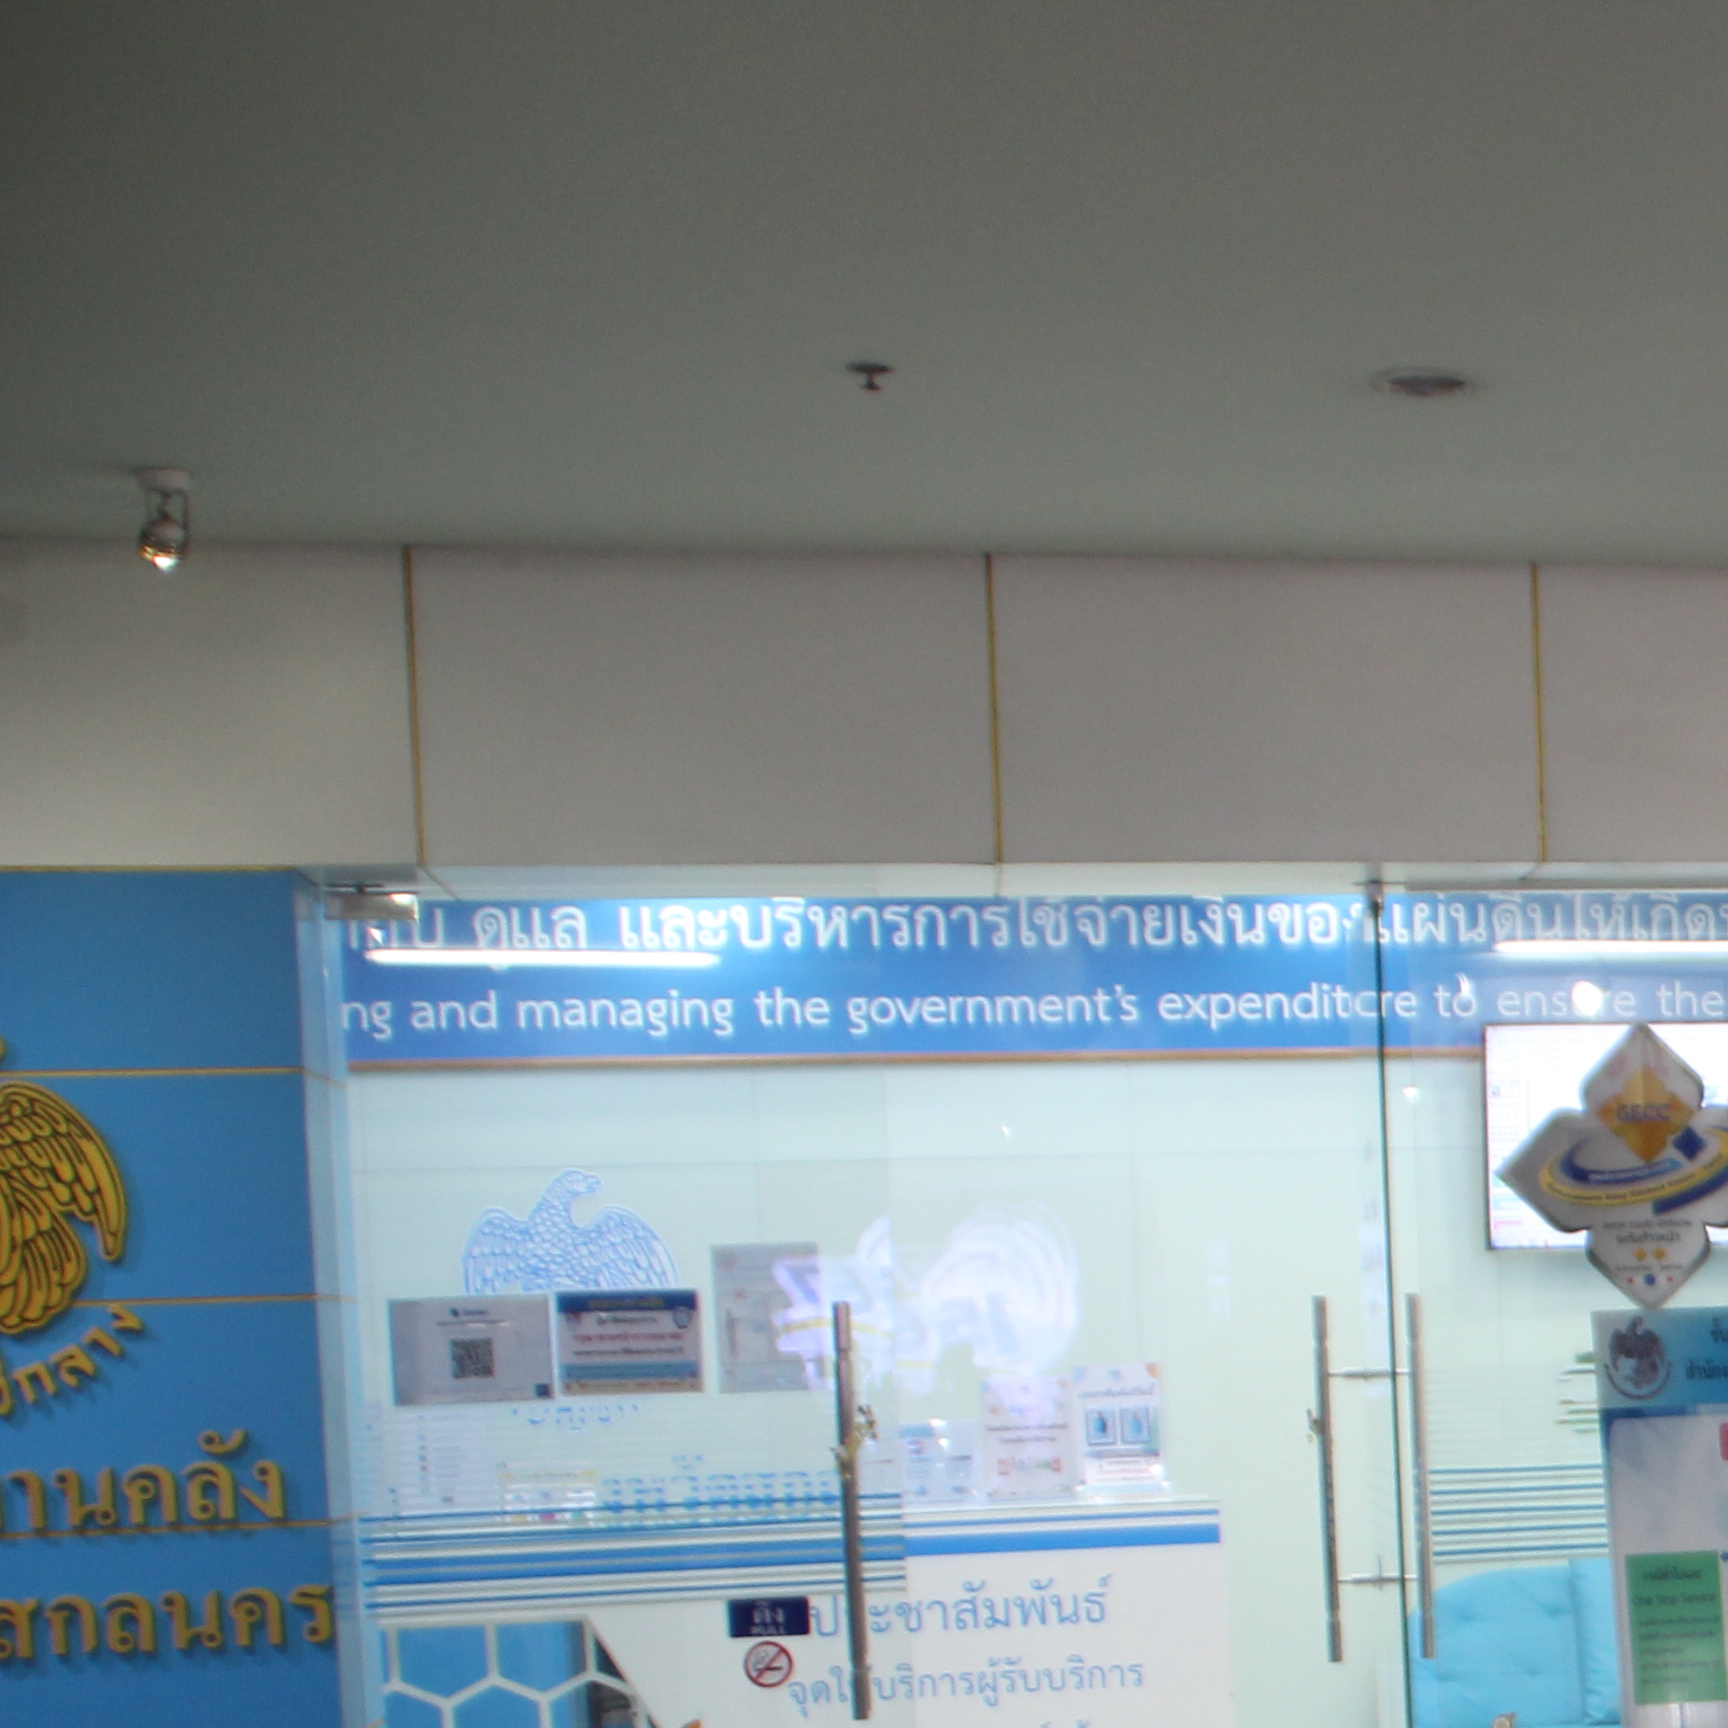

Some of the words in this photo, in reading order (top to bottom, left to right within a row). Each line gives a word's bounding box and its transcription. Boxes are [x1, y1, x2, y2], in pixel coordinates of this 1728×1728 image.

[410, 988, 498, 1031] and
[517, 988, 734, 1039] managing
[754, 985, 830, 1029] the
[846, 983, 1138, 1036] government's
[1433, 980, 1478, 1019] to
[1498, 984, 1636, 1018] ensre
[1657, 977, 1726, 1017] the
[0, 1583, 336, 1660] สกลนคร
[810, 1572, 1110, 1639] ปะชาสัมพันธ์
[787, 1653, 1144, 1719] จุดใบริการผู้รับบริการ
